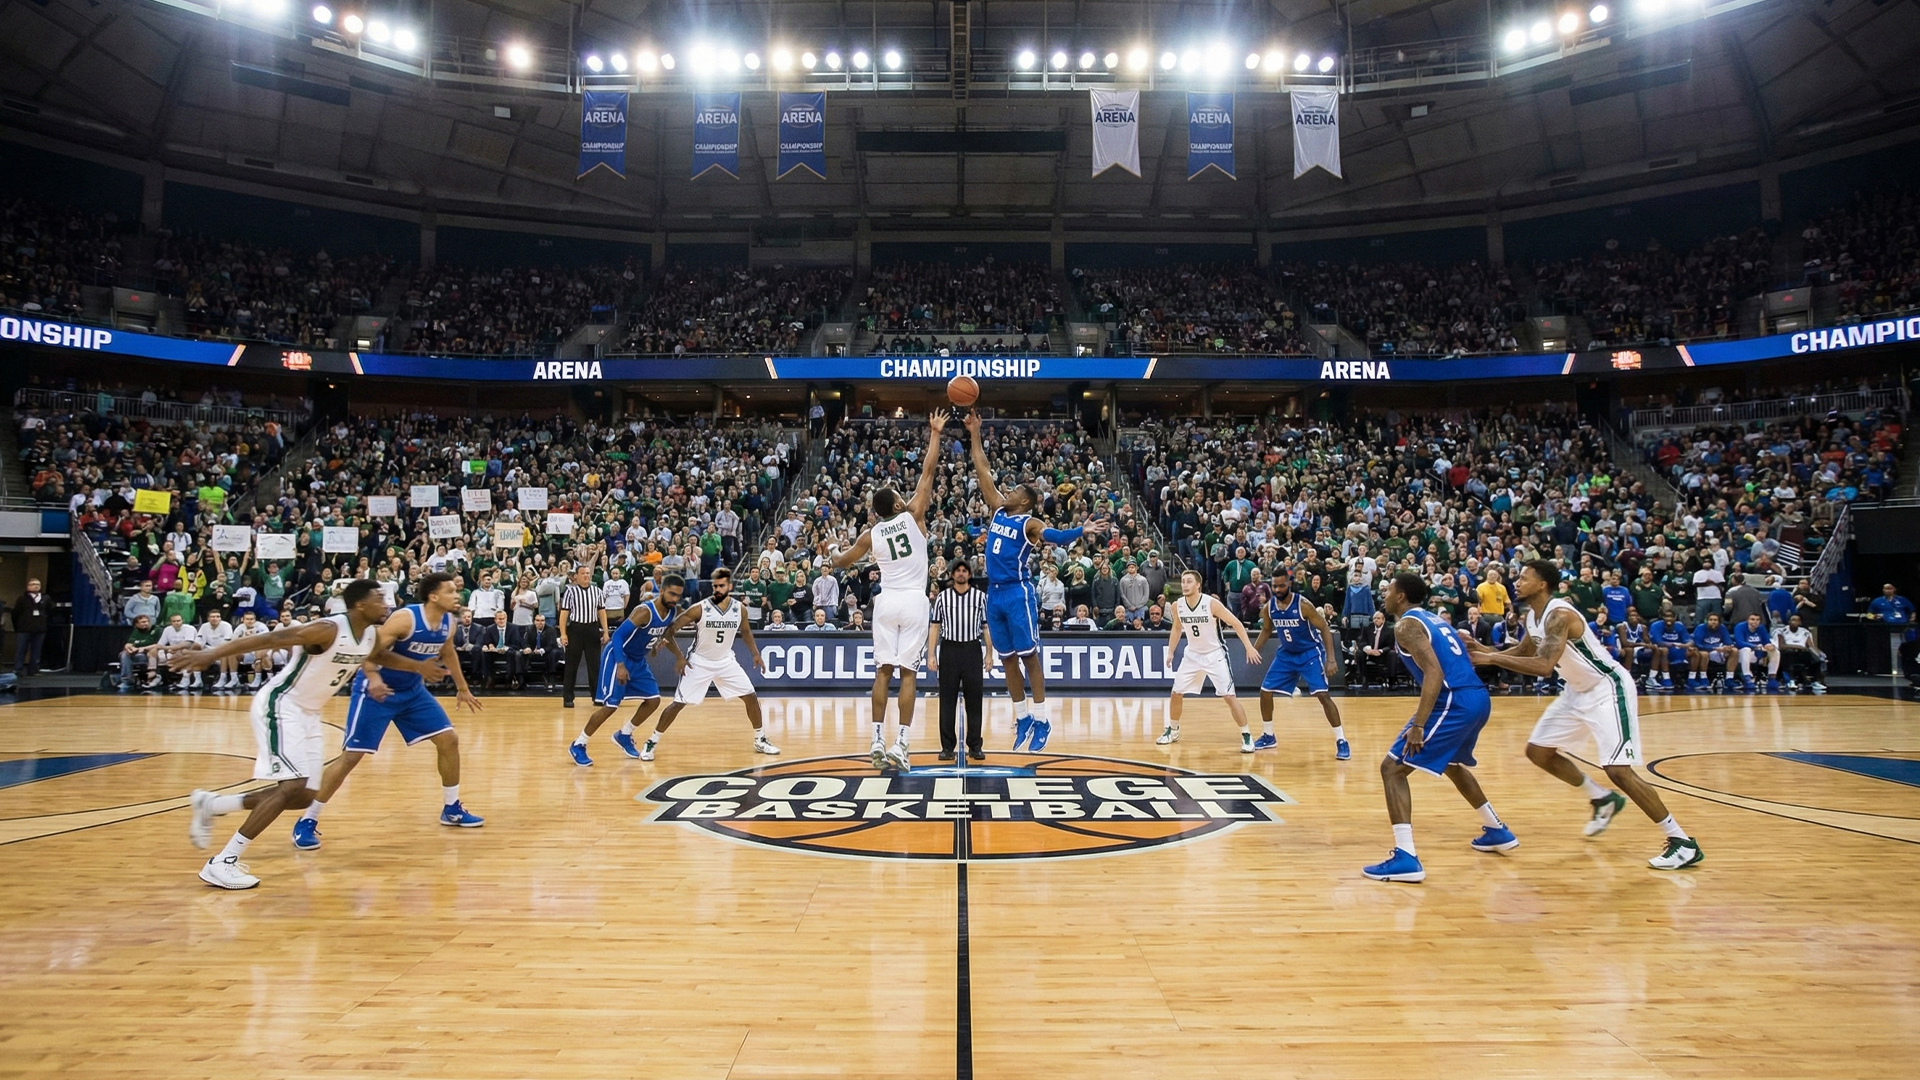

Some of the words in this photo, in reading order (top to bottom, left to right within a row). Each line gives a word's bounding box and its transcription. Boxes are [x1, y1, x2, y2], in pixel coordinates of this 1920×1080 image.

[584, 111, 625, 123] ARENA
[696, 112, 738, 124] ARENA
[781, 111, 823, 124] ARENA
[1095, 112, 1136, 123] ARENA
[1190, 112, 1231, 124] ARENA
[1296, 113, 1336, 126] ARENA
[0, 317, 112, 350] ONSHIP
[533, 361, 602, 380] ARENA
[880, 359, 1041, 378] CHAMPIONSHIP
[1320, 361, 1391, 380] ARENA
[886, 533, 913, 561] 13
[715, 631, 725, 644] 5
[1191, 625, 1200, 637] 8
[664, 776, 1266, 801] COLLEGE
[676, 801, 1256, 819] BASKETBALL
